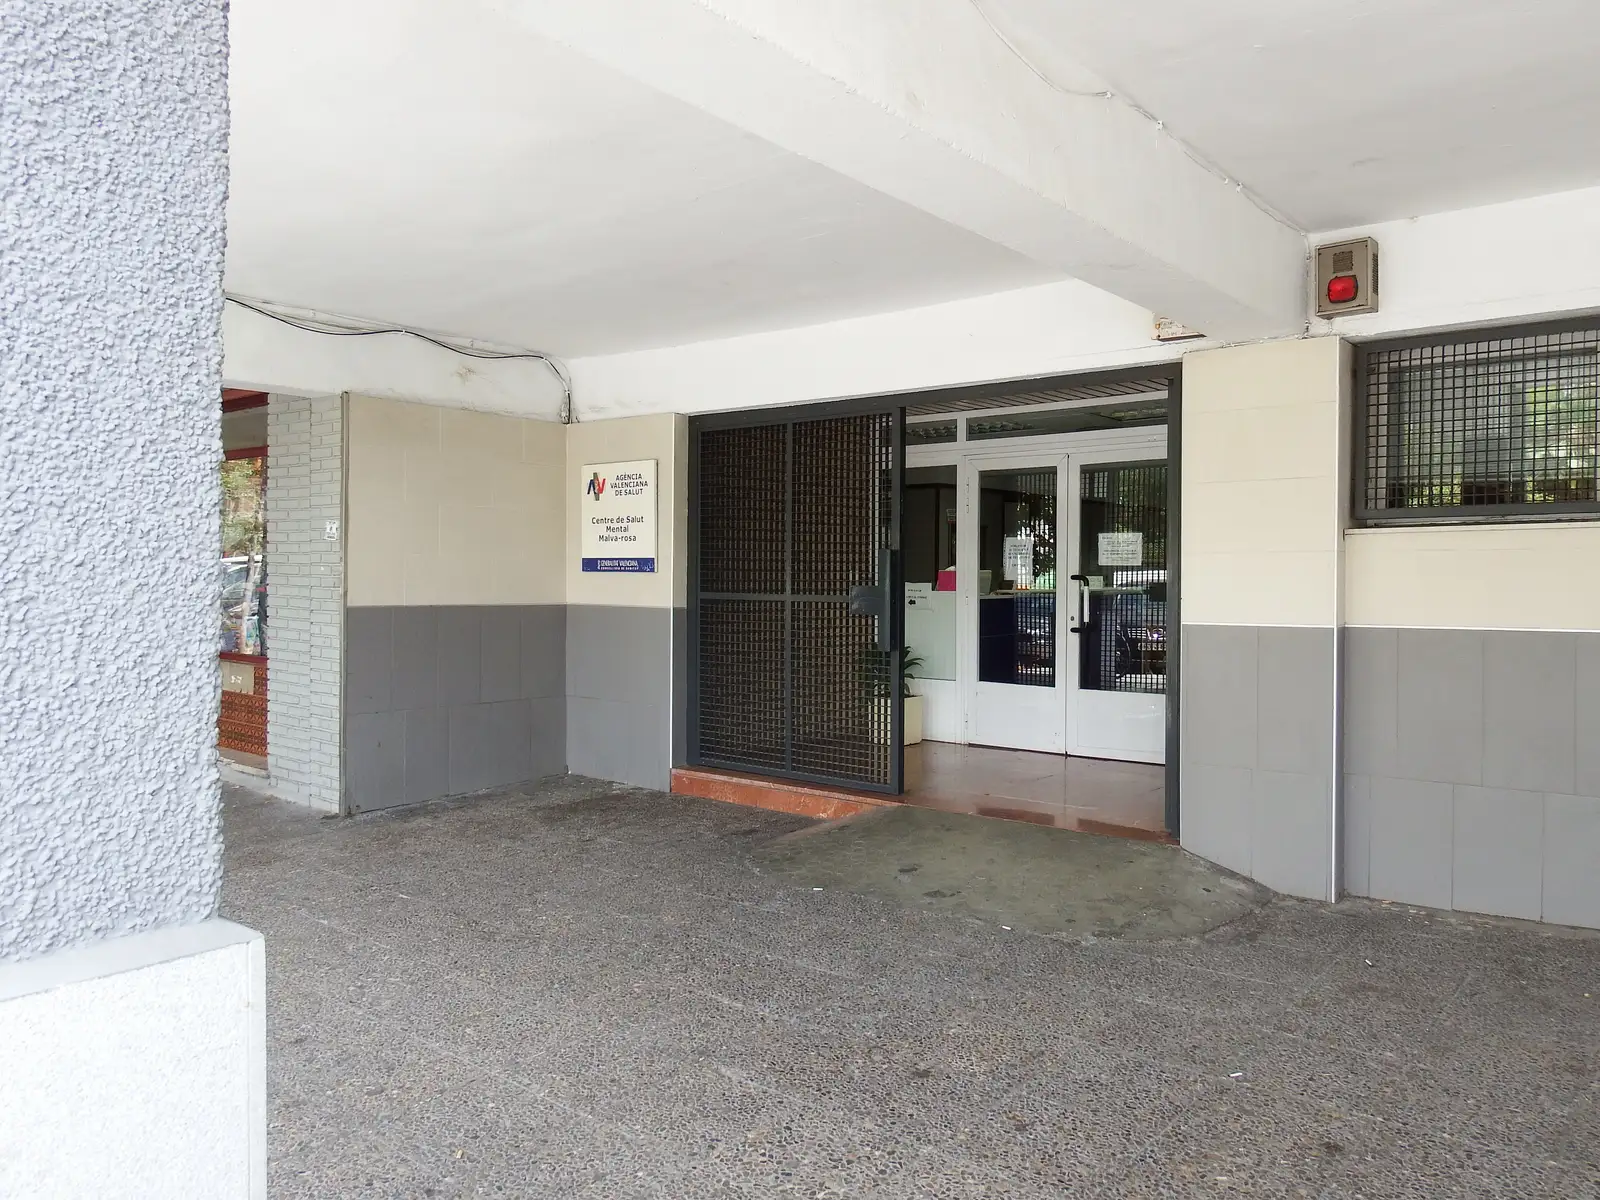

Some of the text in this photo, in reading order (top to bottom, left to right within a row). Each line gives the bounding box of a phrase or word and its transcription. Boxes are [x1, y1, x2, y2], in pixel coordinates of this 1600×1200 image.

[610, 480, 648, 489] VALENCIANA
[614, 488, 643, 497] DE SALUT
[591, 515, 644, 524] Centre de Salut
[606, 525, 629, 533] Mental
[598, 534, 637, 542] Malva-rosa
